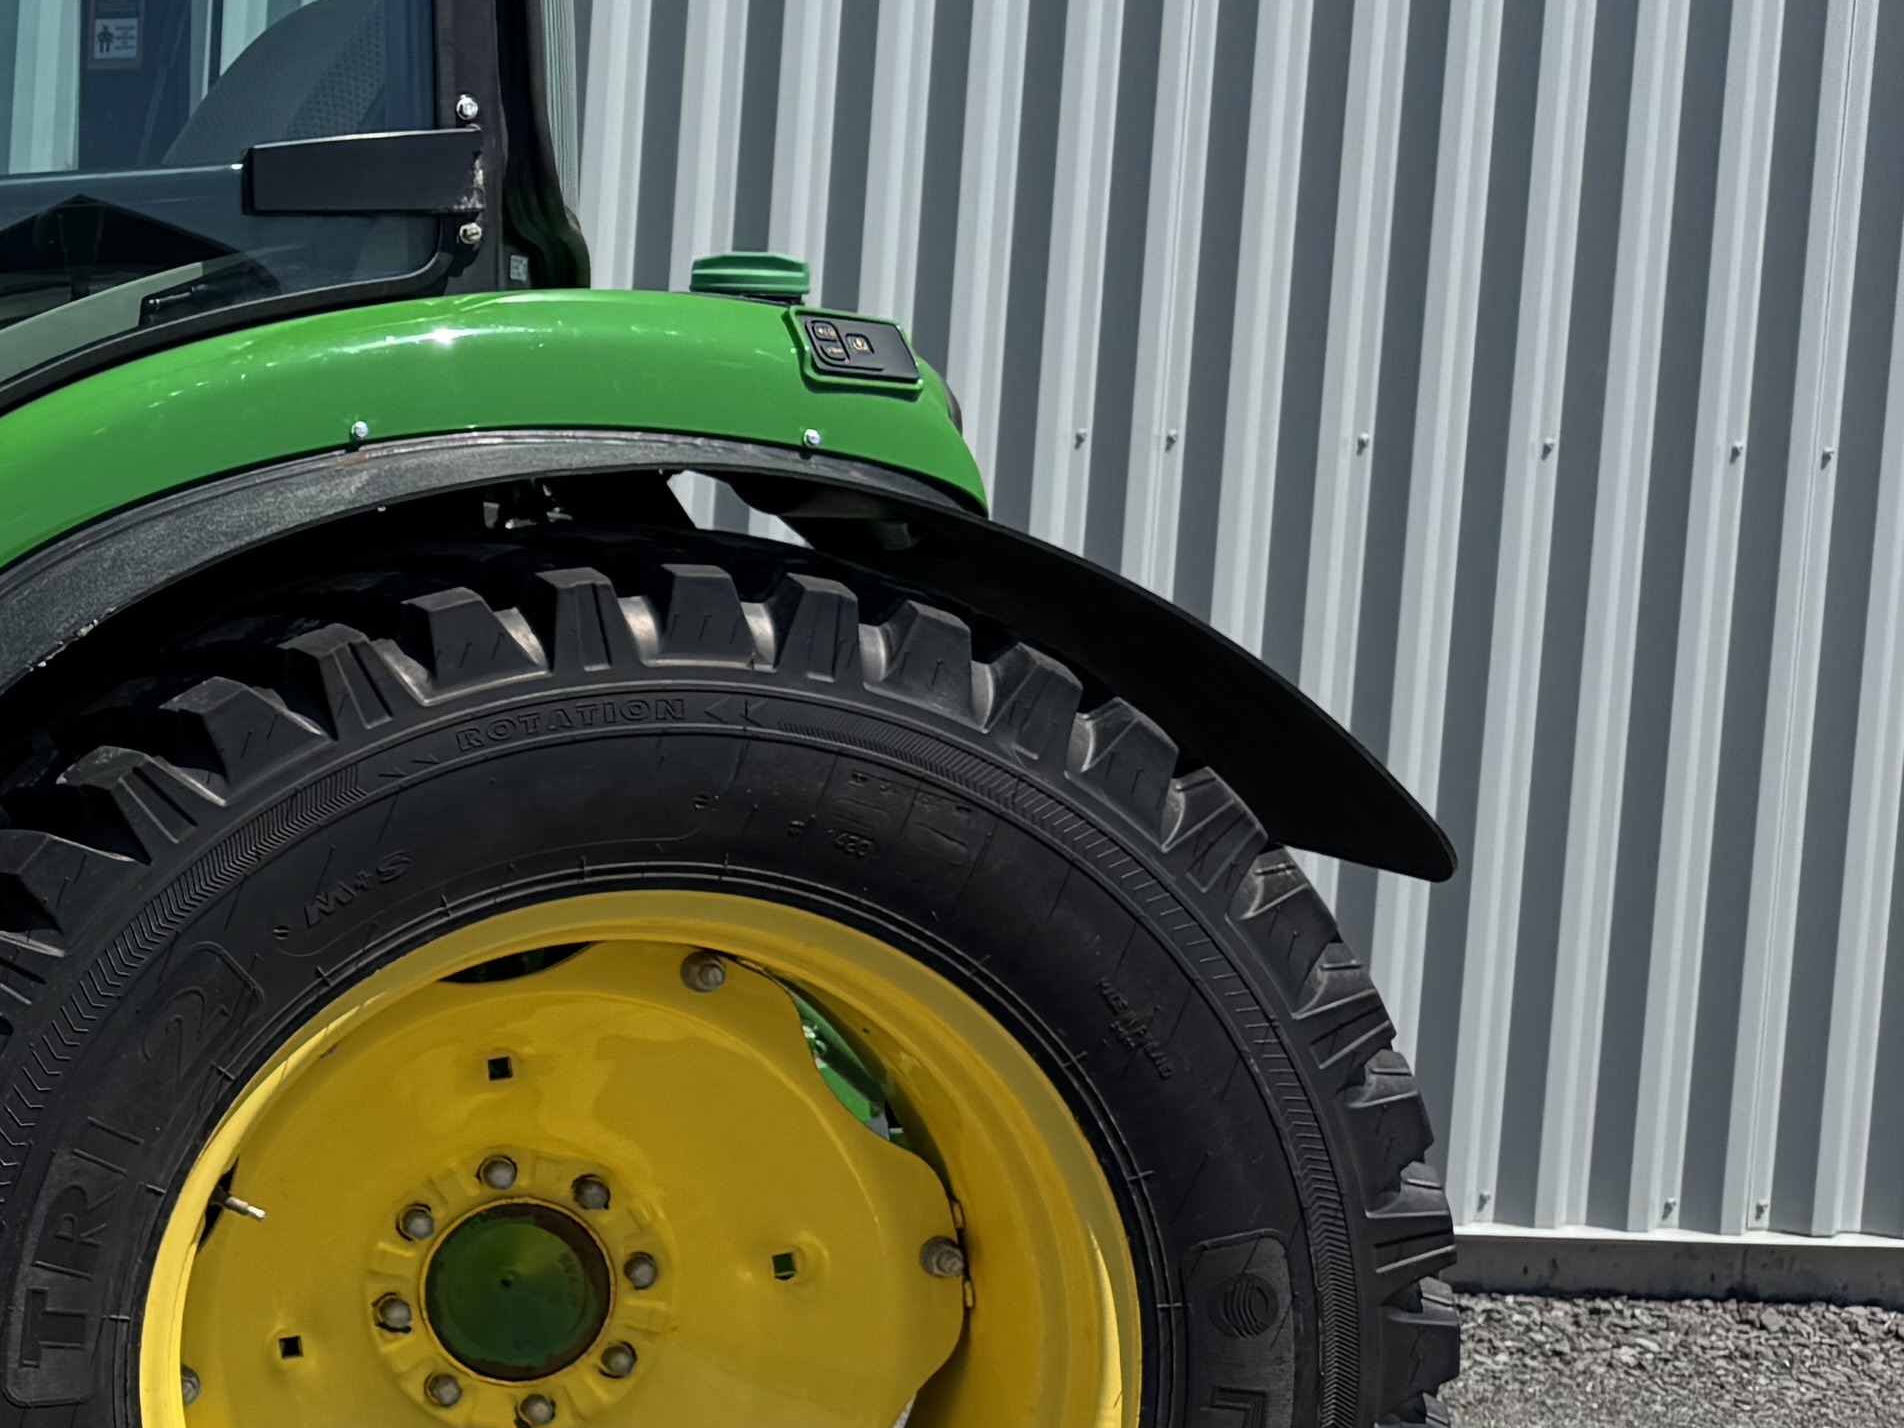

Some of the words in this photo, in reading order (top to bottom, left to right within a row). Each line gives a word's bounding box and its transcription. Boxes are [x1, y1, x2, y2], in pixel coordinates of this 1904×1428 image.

[454, 694, 685, 754] ROTATION
[303, 849, 413, 924] M+S
[21, 1116, 141, 1367] TRI
[138, 985, 230, 1081] 2
